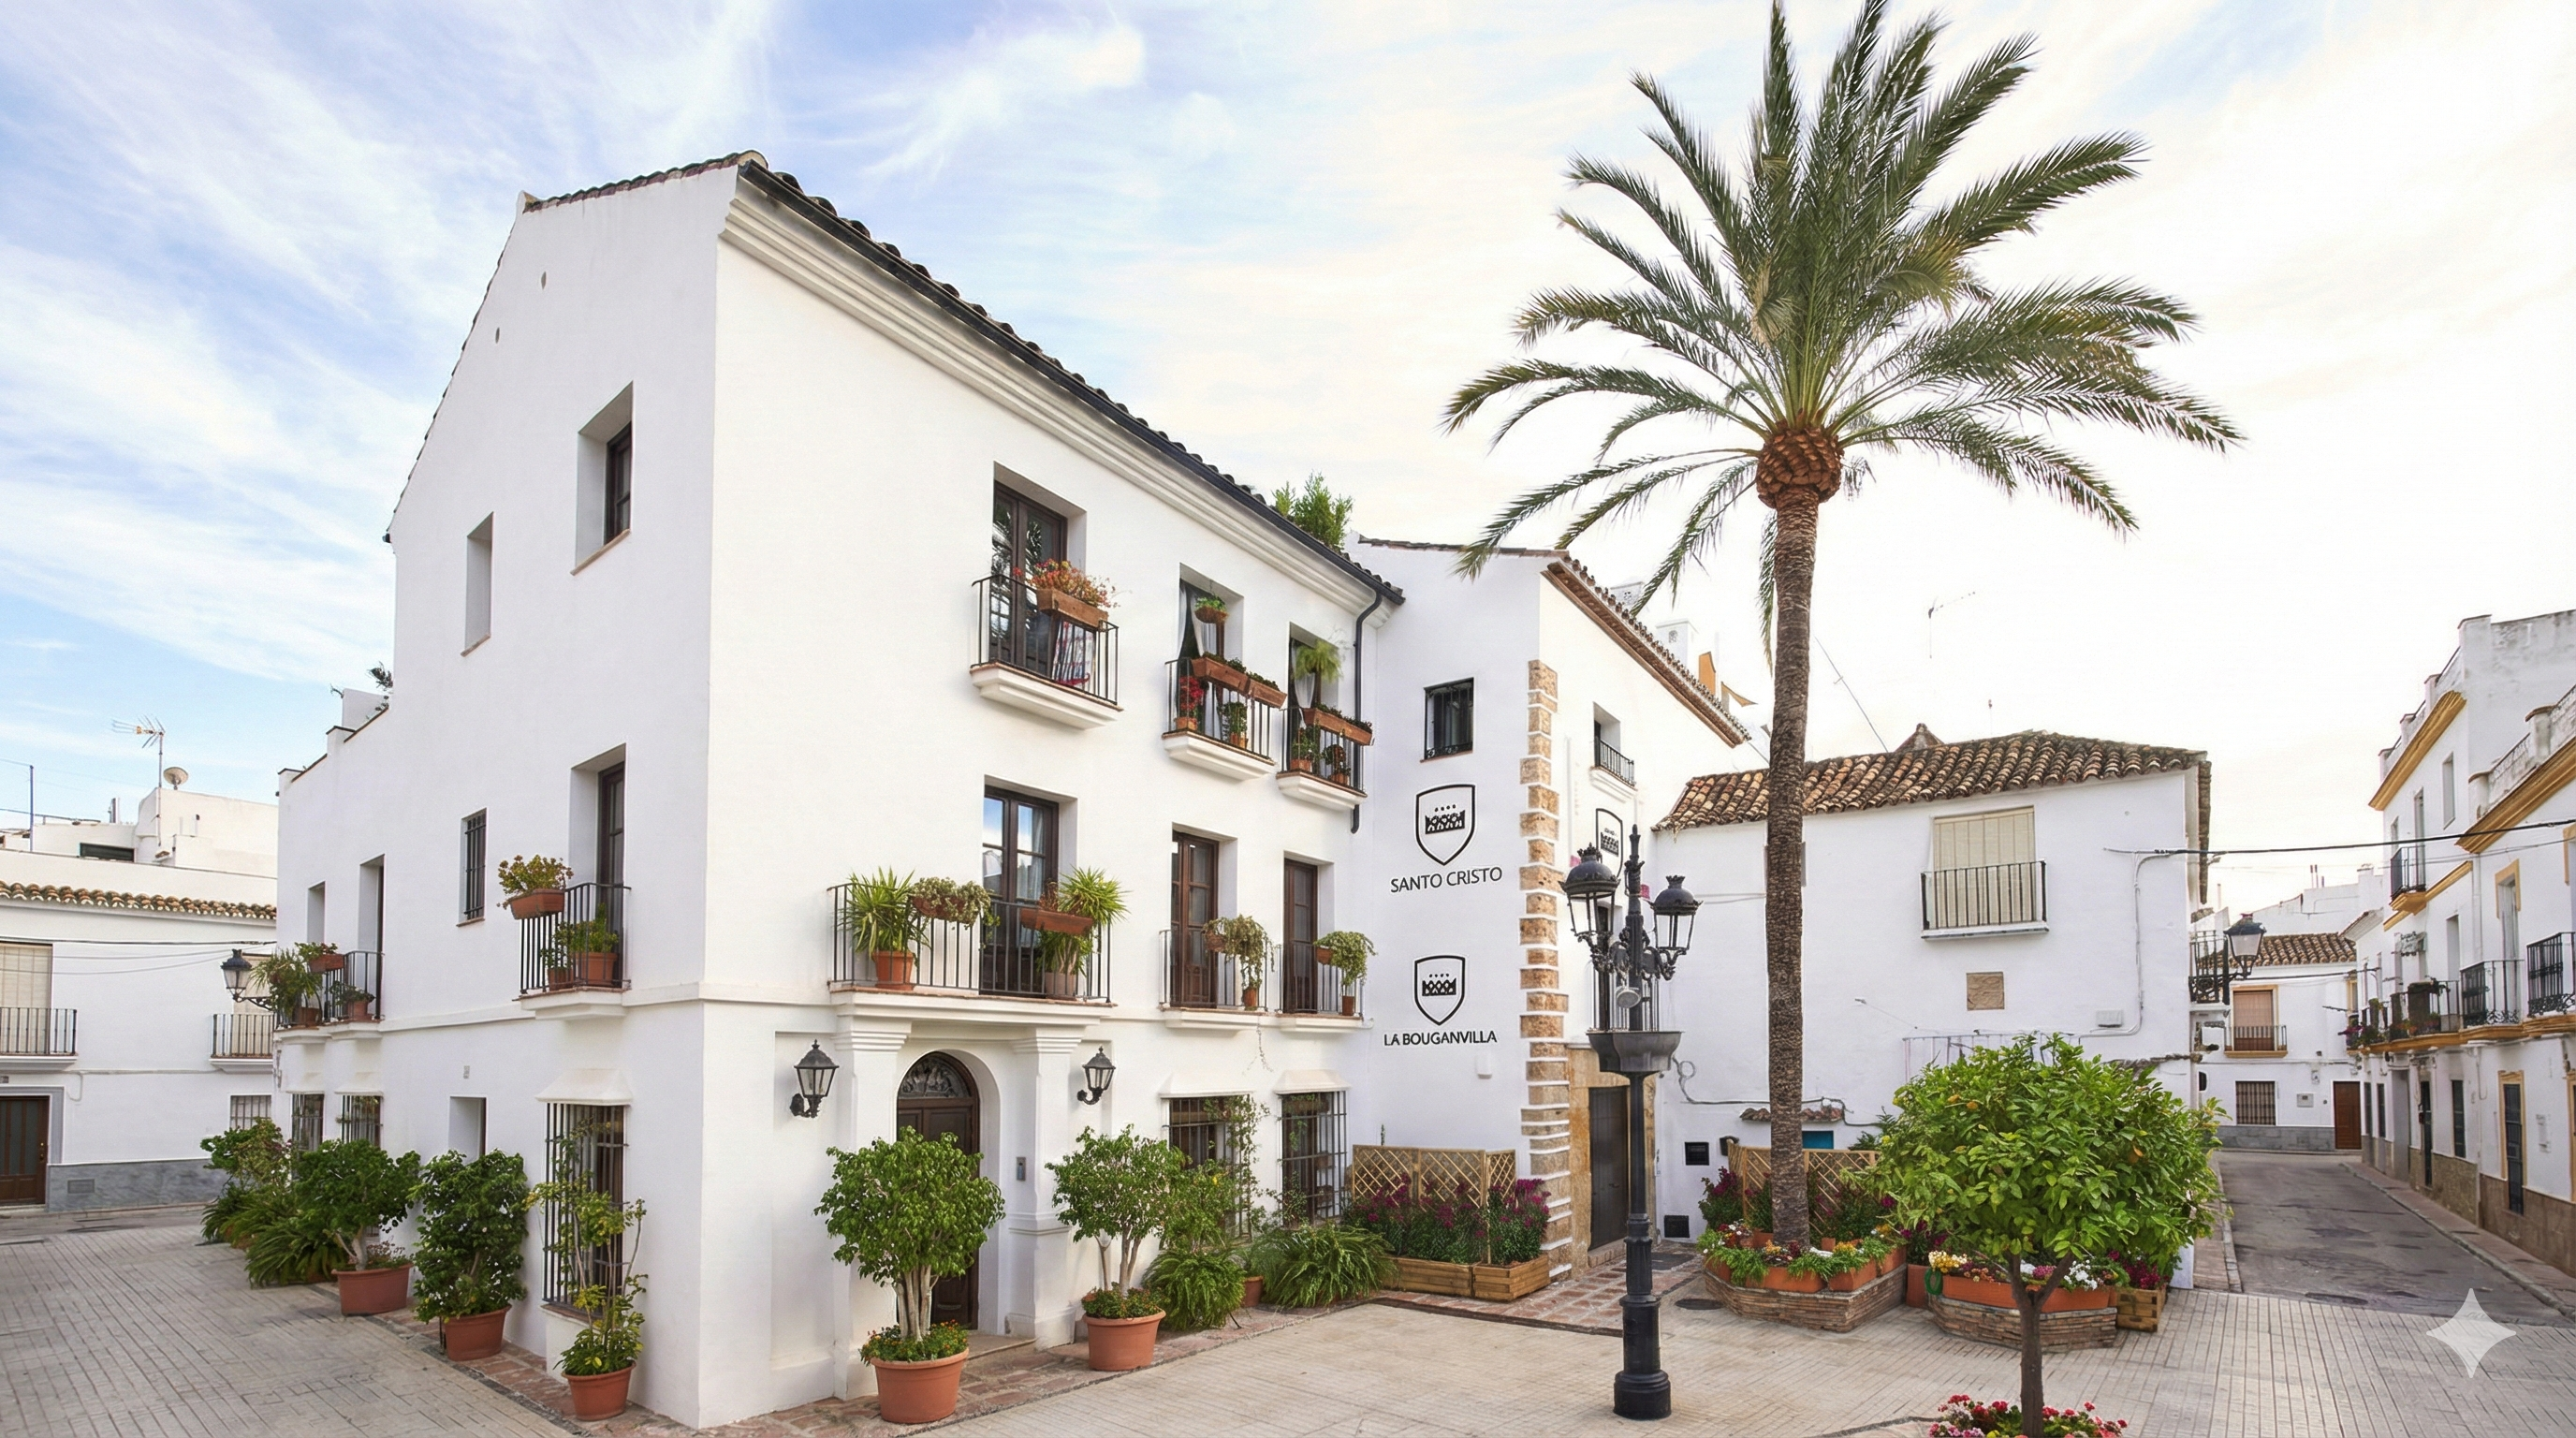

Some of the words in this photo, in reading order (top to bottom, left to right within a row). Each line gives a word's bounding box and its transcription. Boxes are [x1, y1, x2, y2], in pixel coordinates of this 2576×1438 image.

[1390, 873, 1442, 893] SANTO
[1446, 867, 1502, 887] CRISTO
[1383, 1033, 1400, 1047] LA
[1402, 1031, 1498, 1046] BOUGANVILLA
